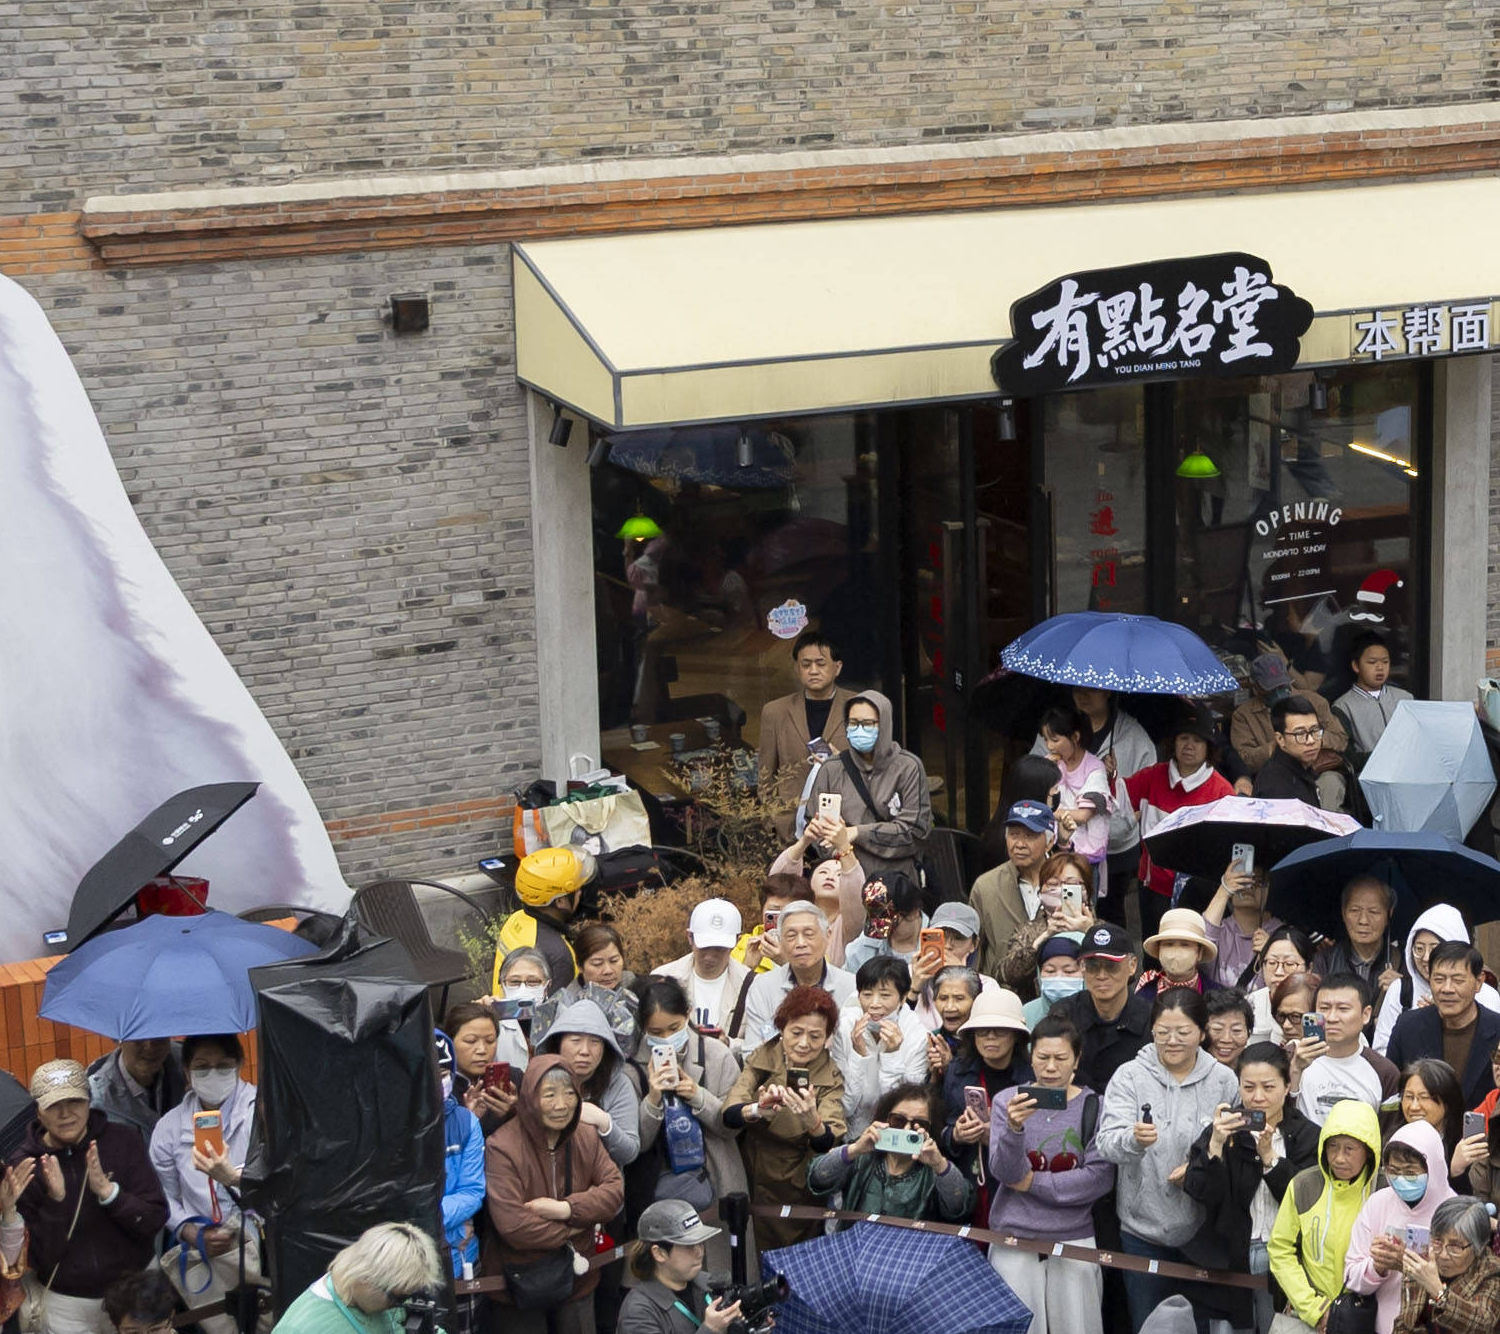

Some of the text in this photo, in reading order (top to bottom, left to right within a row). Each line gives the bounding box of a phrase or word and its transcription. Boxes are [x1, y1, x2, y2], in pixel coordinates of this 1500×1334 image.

[1357, 304, 1491, 359] 本帮面
[1115, 365, 1132, 375] YOU
[1134, 363, 1154, 373] DIAN
[1179, 359, 1202, 369] TANG
[1255, 501, 1342, 536] OPENING
[1289, 530, 1311, 541] TIME
